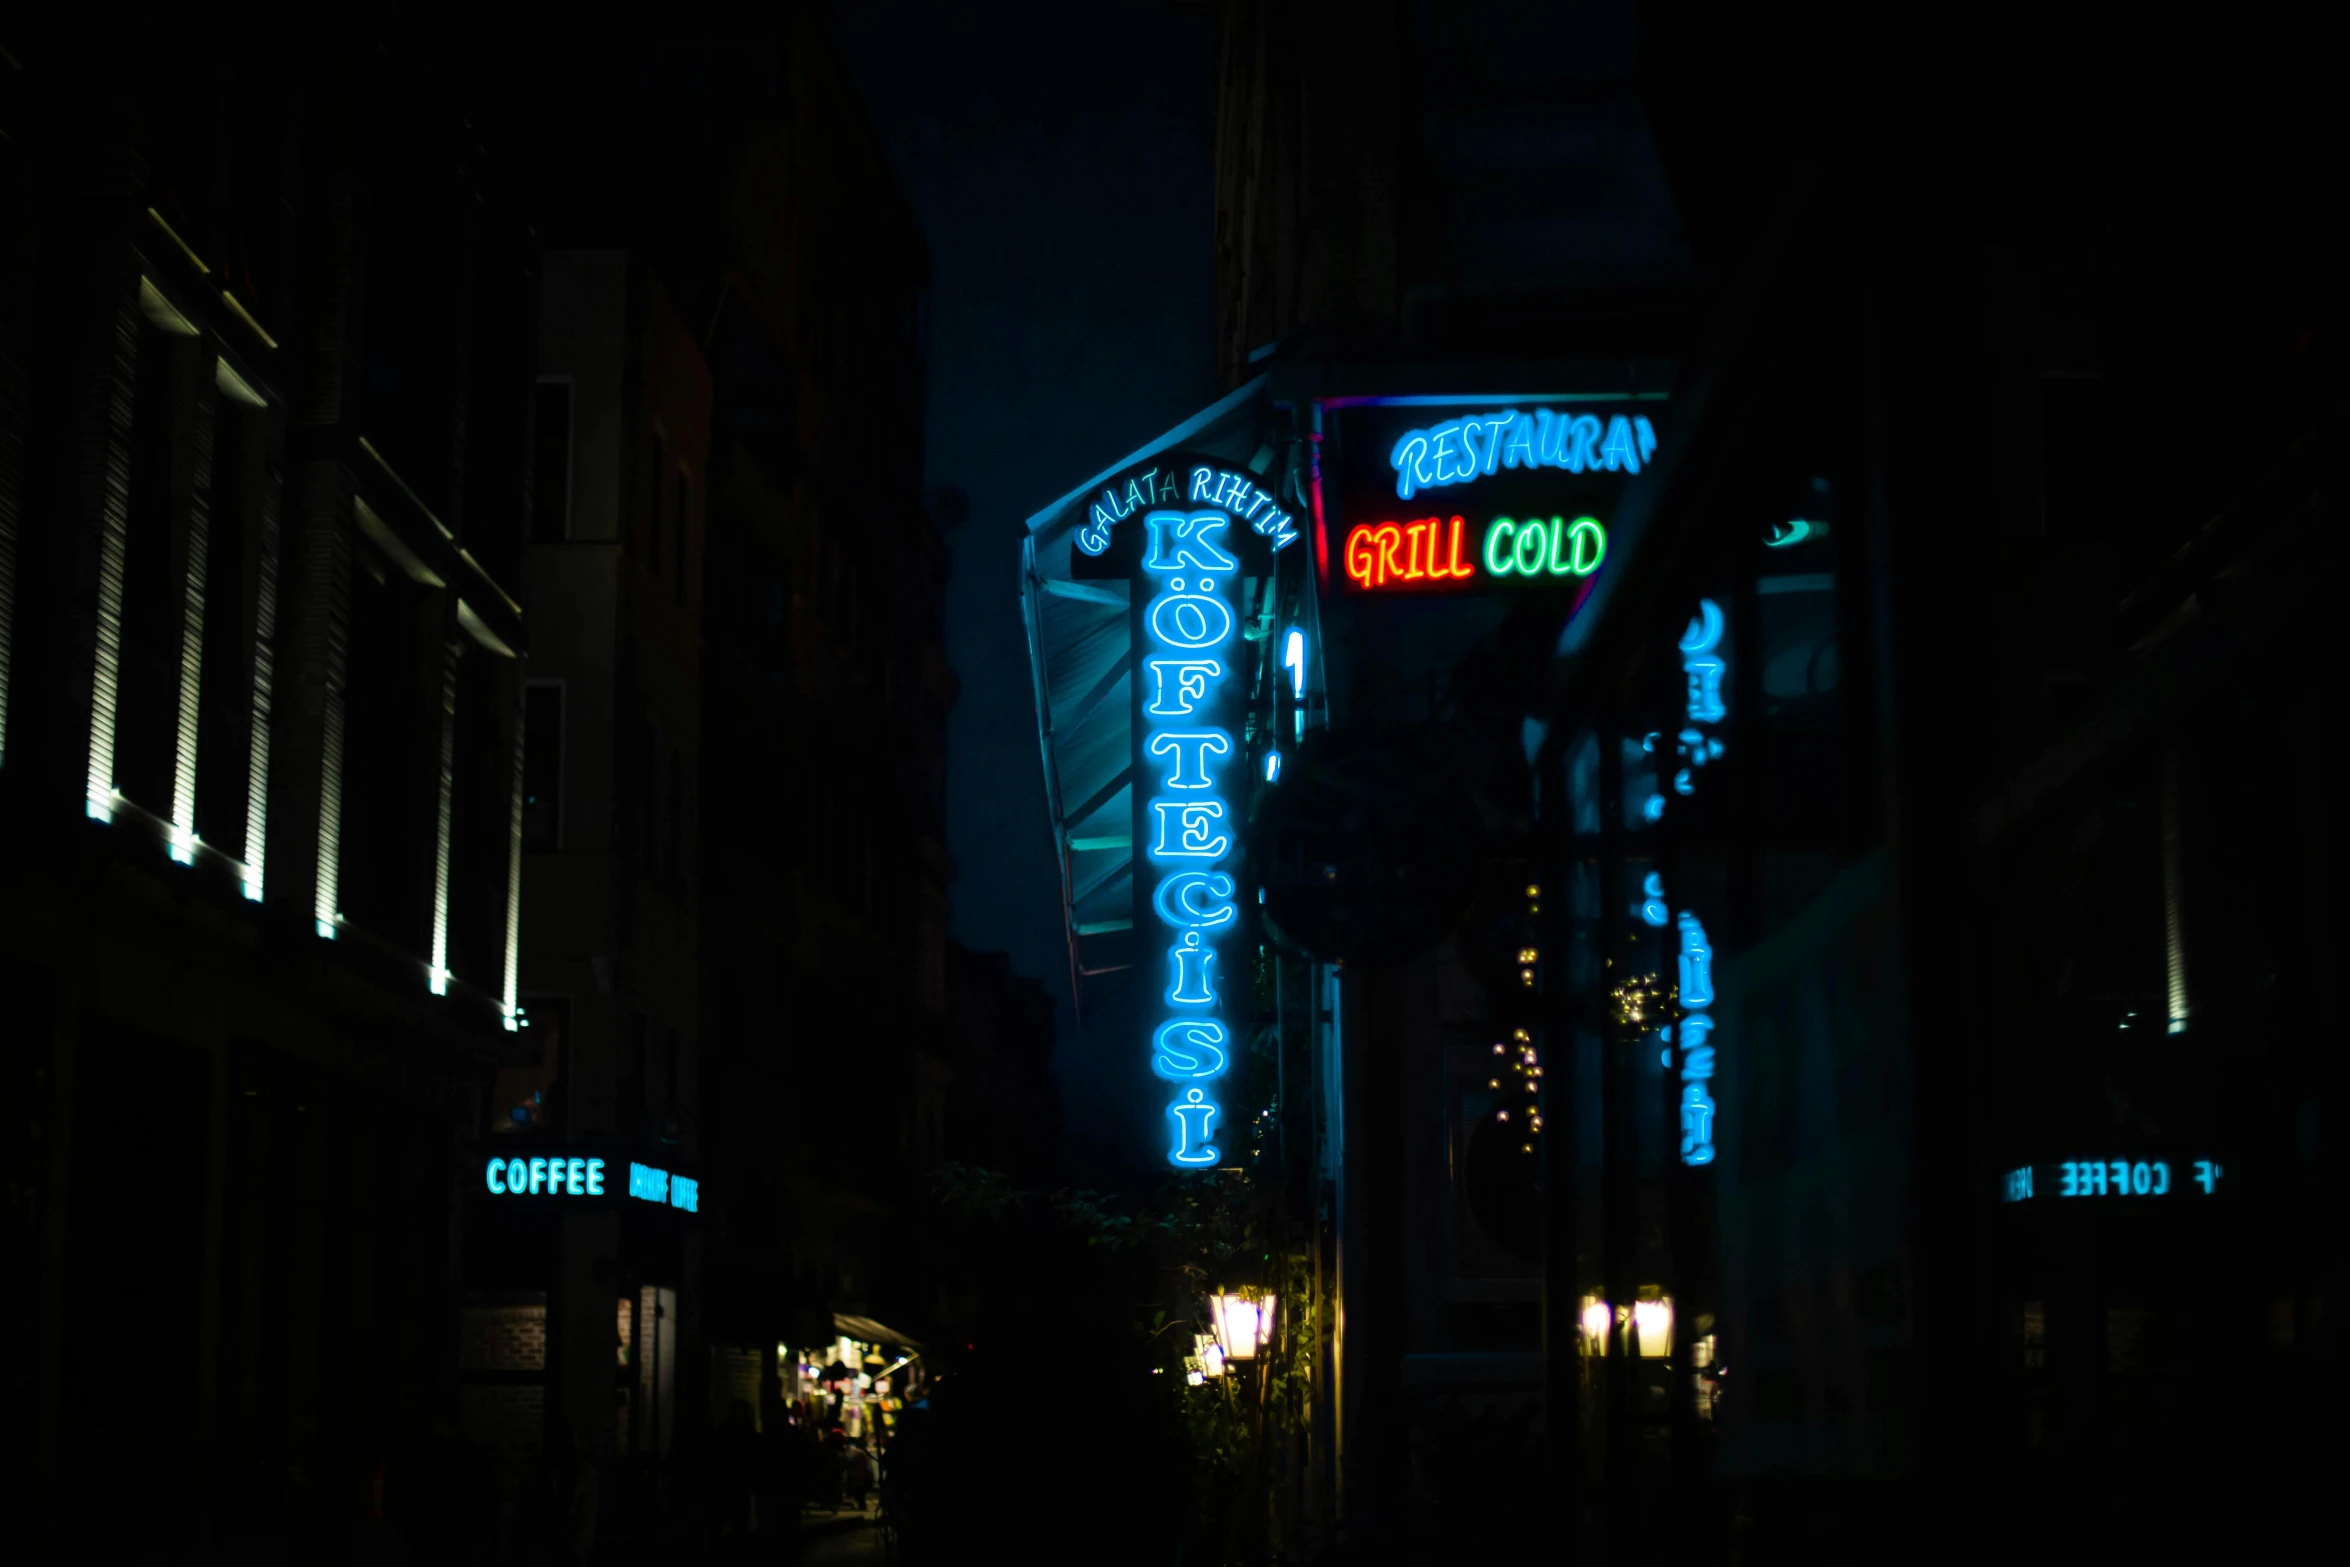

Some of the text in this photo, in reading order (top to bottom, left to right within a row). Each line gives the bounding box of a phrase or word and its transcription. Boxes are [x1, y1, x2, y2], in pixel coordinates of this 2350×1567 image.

[1077, 467, 1181, 554] GALATA
[1346, 516, 1606, 587] GRILL COLD
[1145, 513, 1238, 1166] KÖFTECİSİ
[486, 1157, 605, 1195] COFFEE
